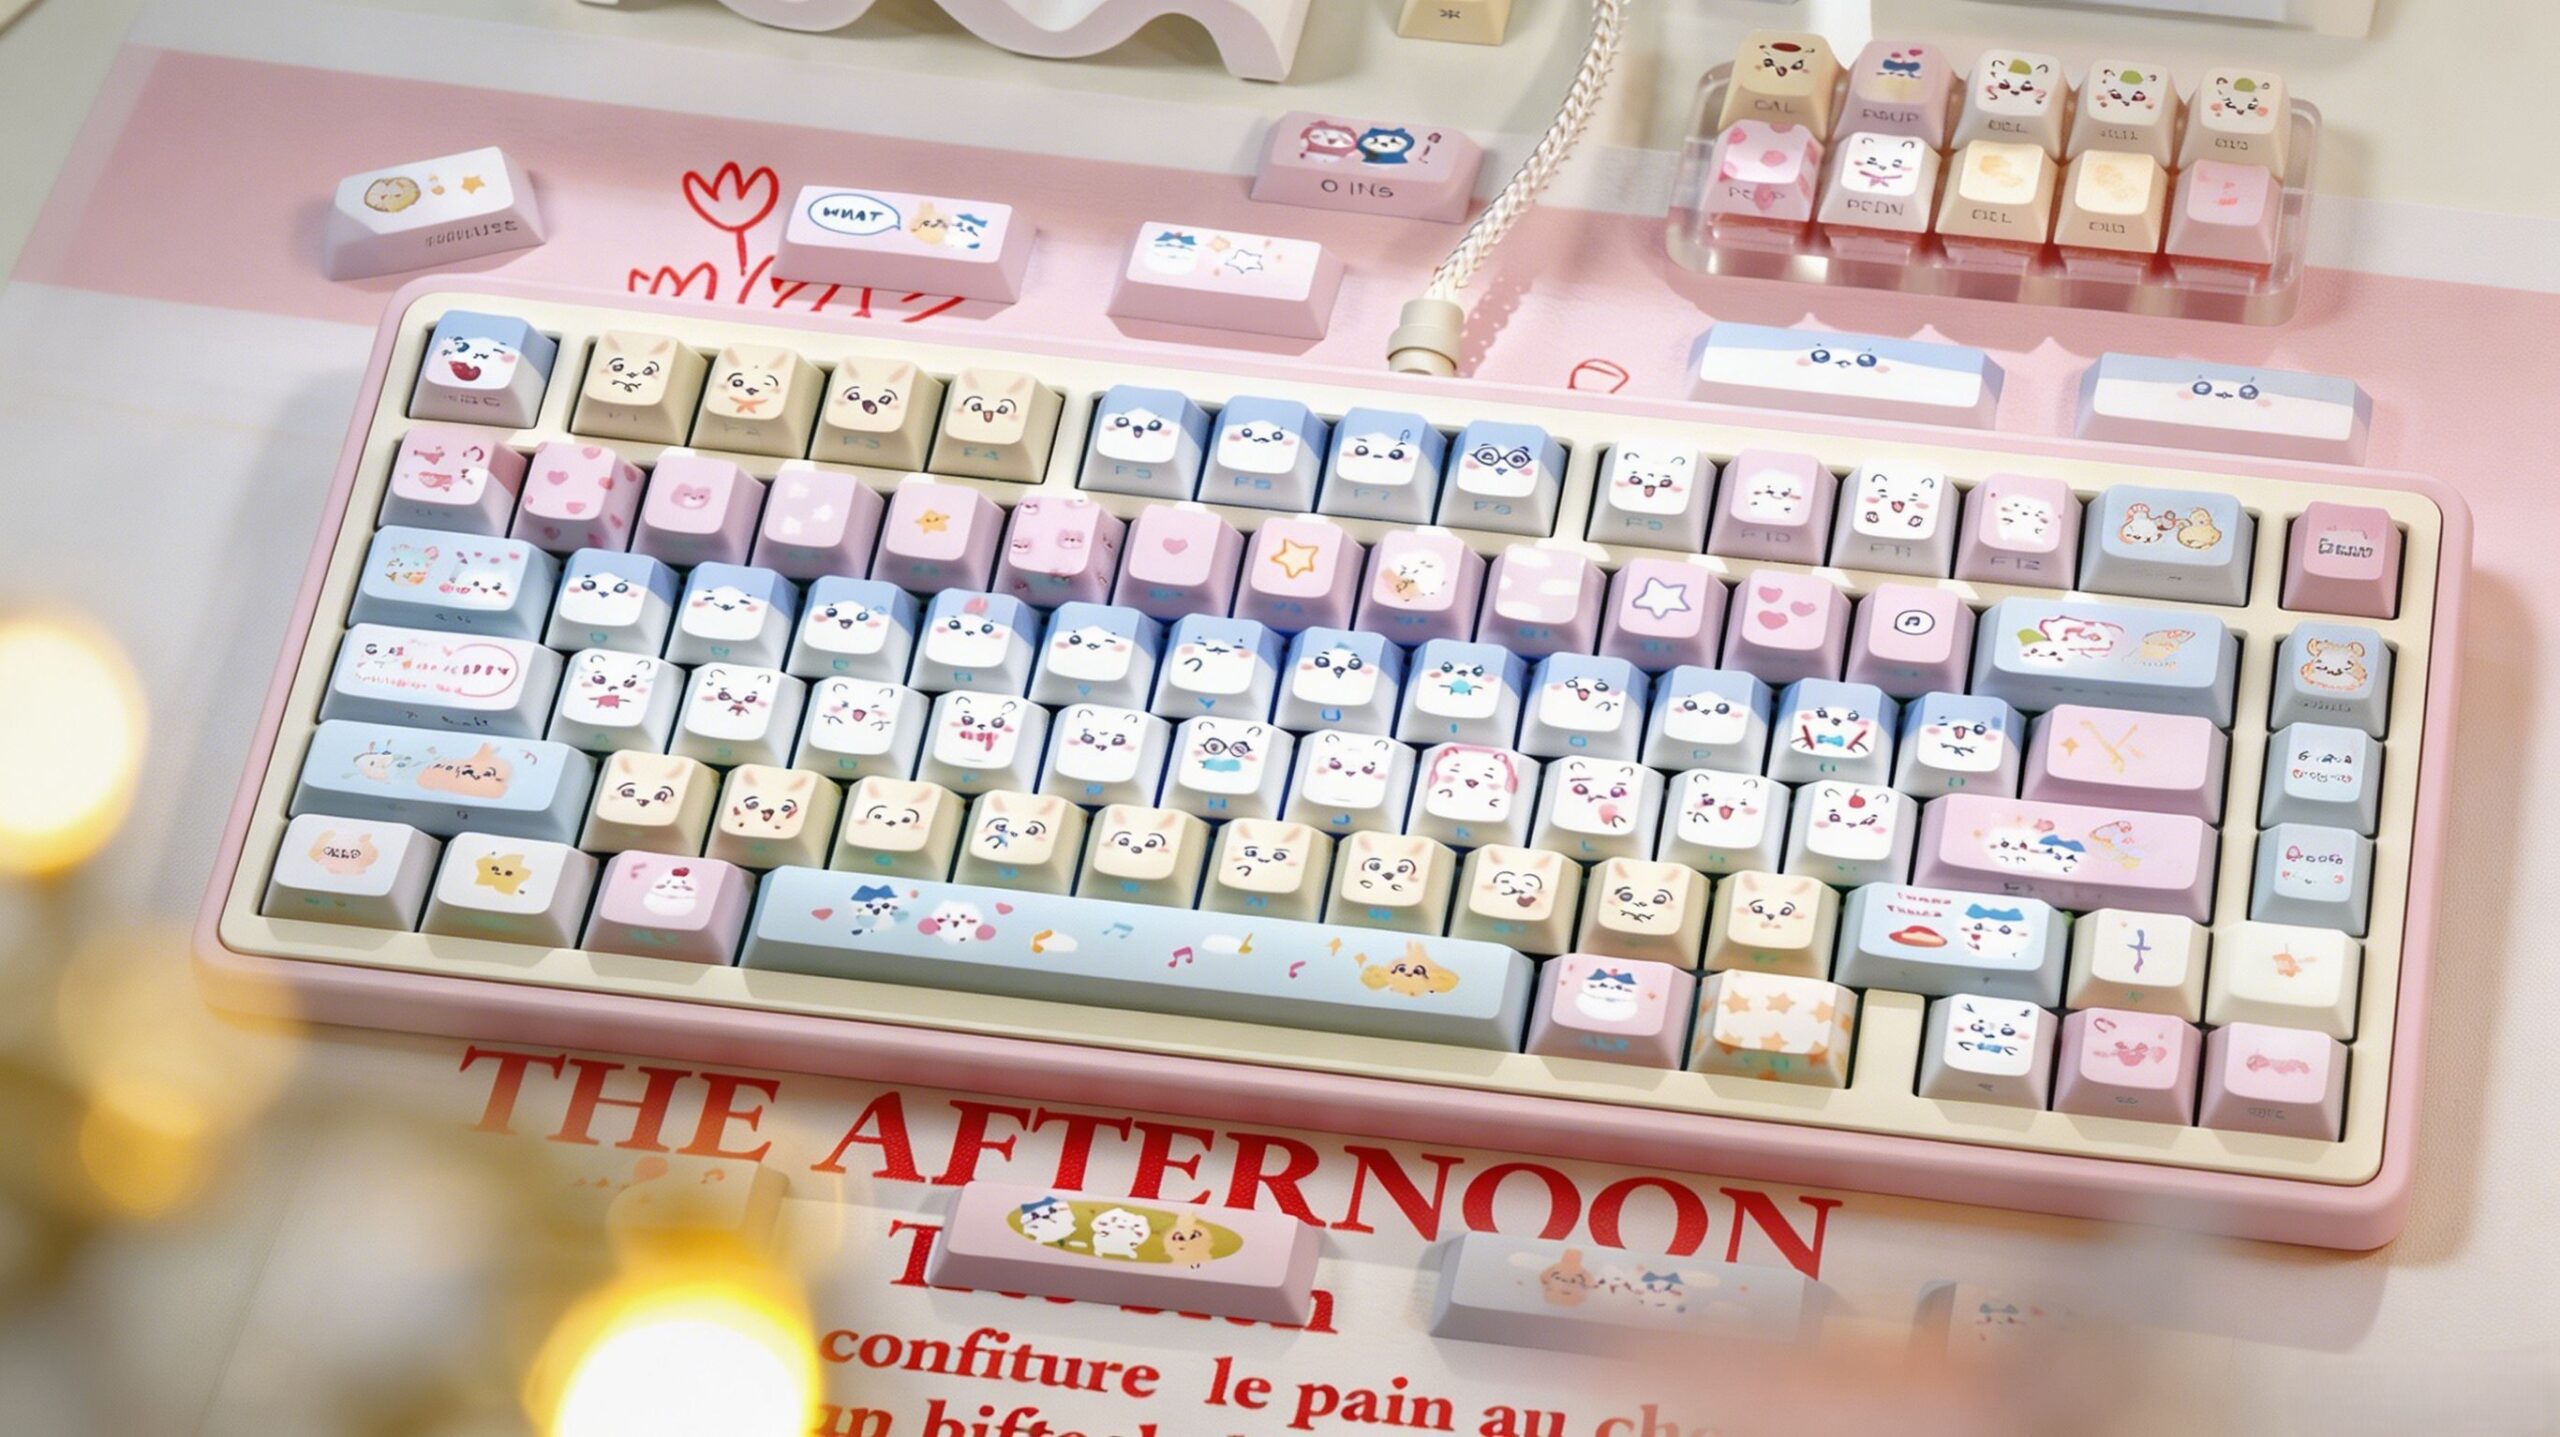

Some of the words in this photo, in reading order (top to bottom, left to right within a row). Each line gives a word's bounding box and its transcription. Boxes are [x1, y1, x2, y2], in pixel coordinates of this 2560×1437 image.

[1350, 181, 1394, 199] INS
[459, 1045, 782, 1163] THE
[810, 1090, 1843, 1280] AFTERNOON
[819, 1327, 1160, 1398] confiture
[1204, 1356, 1272, 1409] le
[1288, 1376, 1454, 1431] pain
[1479, 1406, 1566, 1437] au
